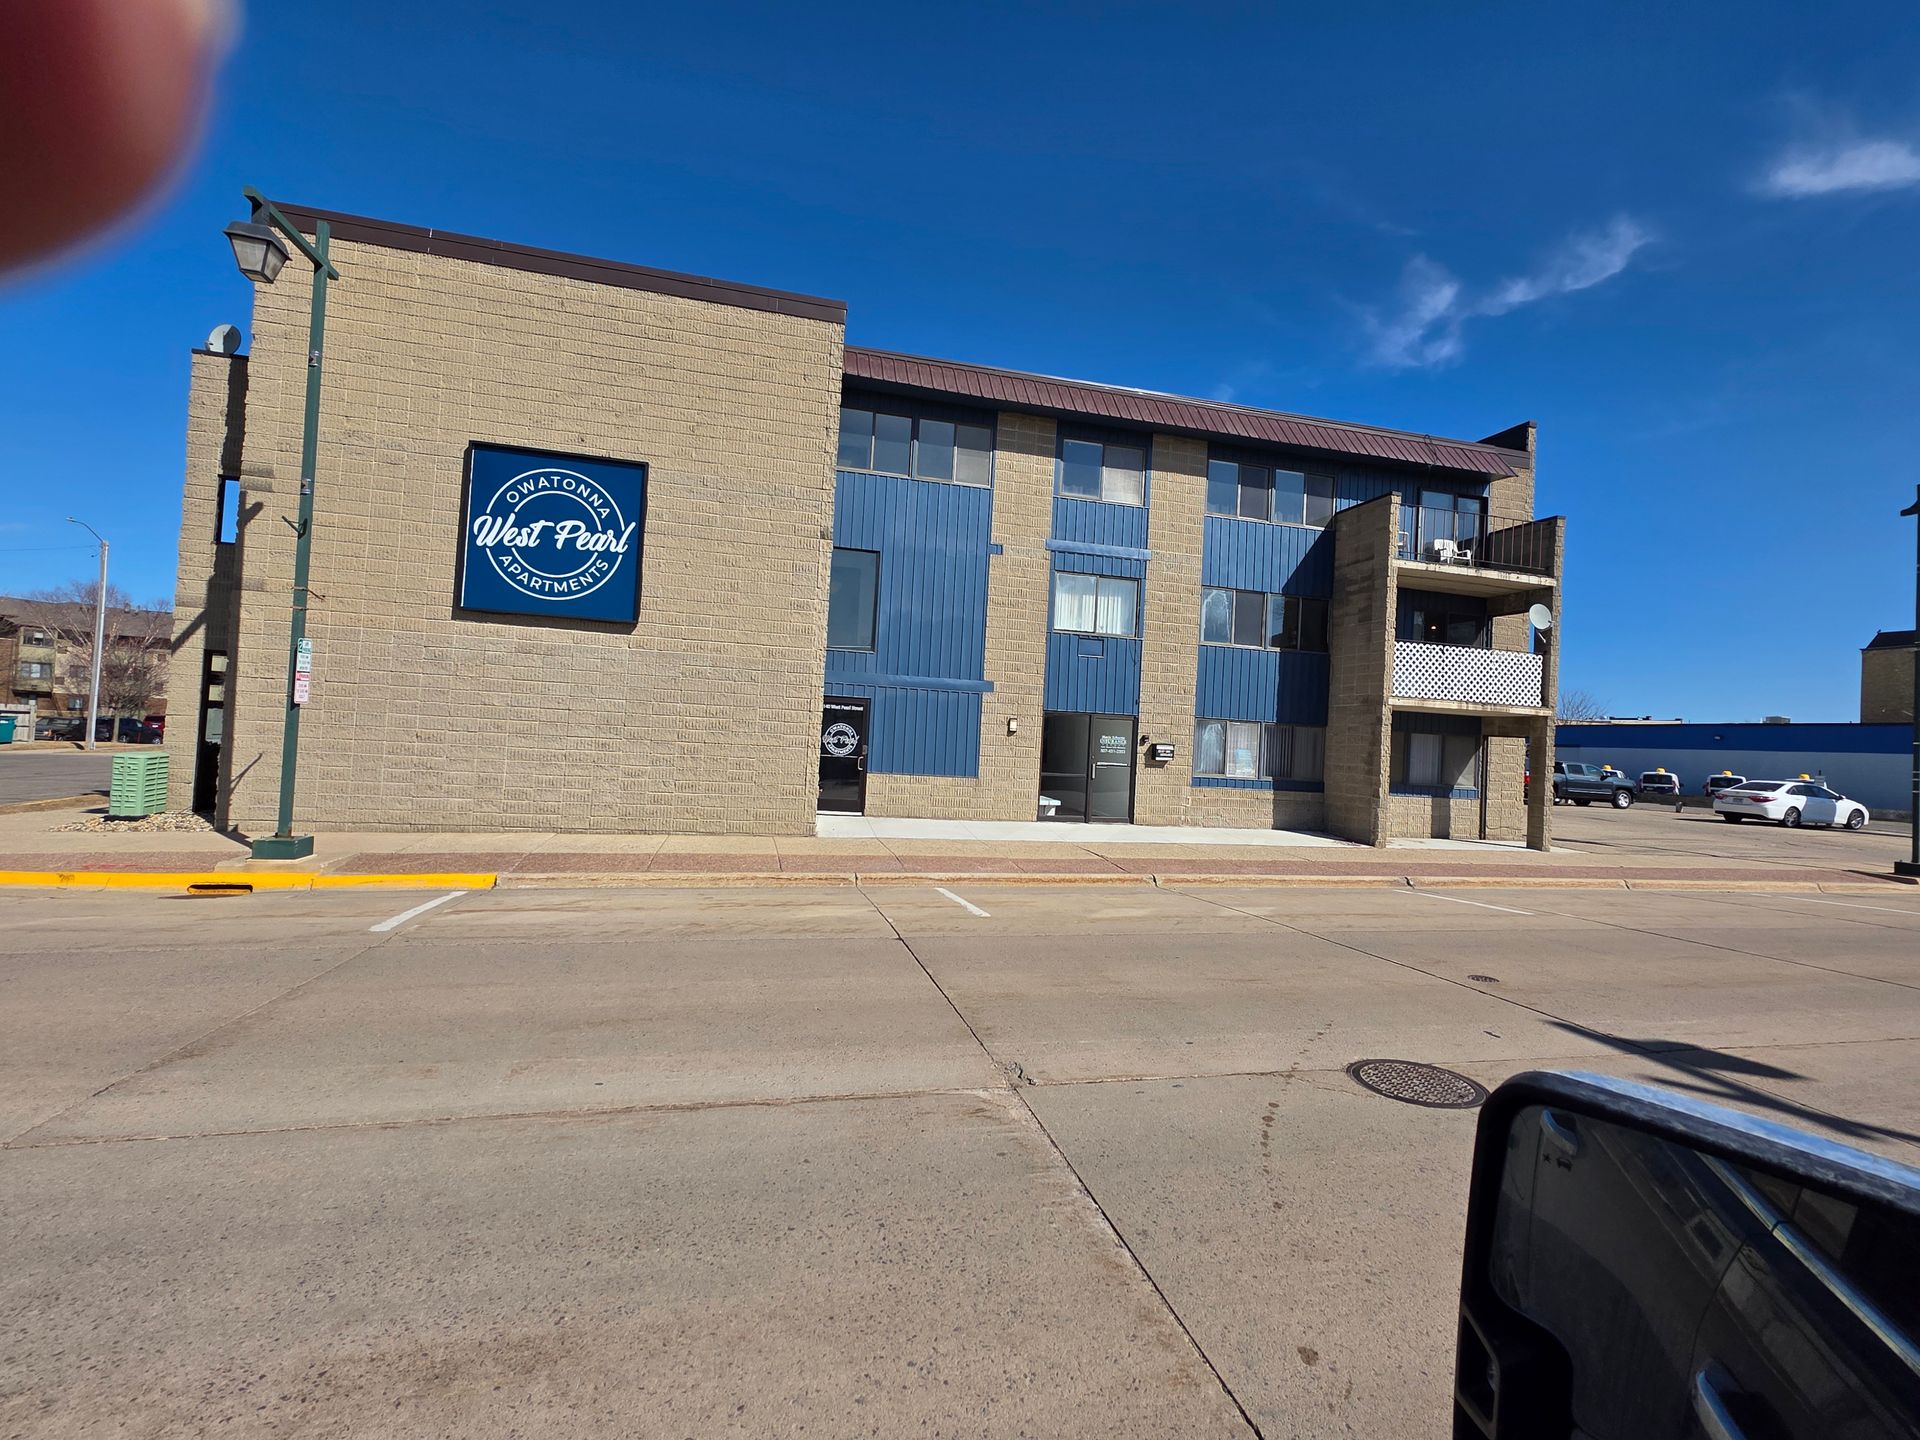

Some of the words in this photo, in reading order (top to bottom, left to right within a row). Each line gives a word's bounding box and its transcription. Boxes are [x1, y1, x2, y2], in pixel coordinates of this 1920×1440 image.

[506, 475, 611, 519] OWATONNA
[473, 512, 555, 548] West
[554, 520, 637, 553] Pearl
[498, 554, 609, 593] APARTMENTS
[828, 744, 853, 754] APARTMENTS
[829, 724, 854, 736] OWATONNA
